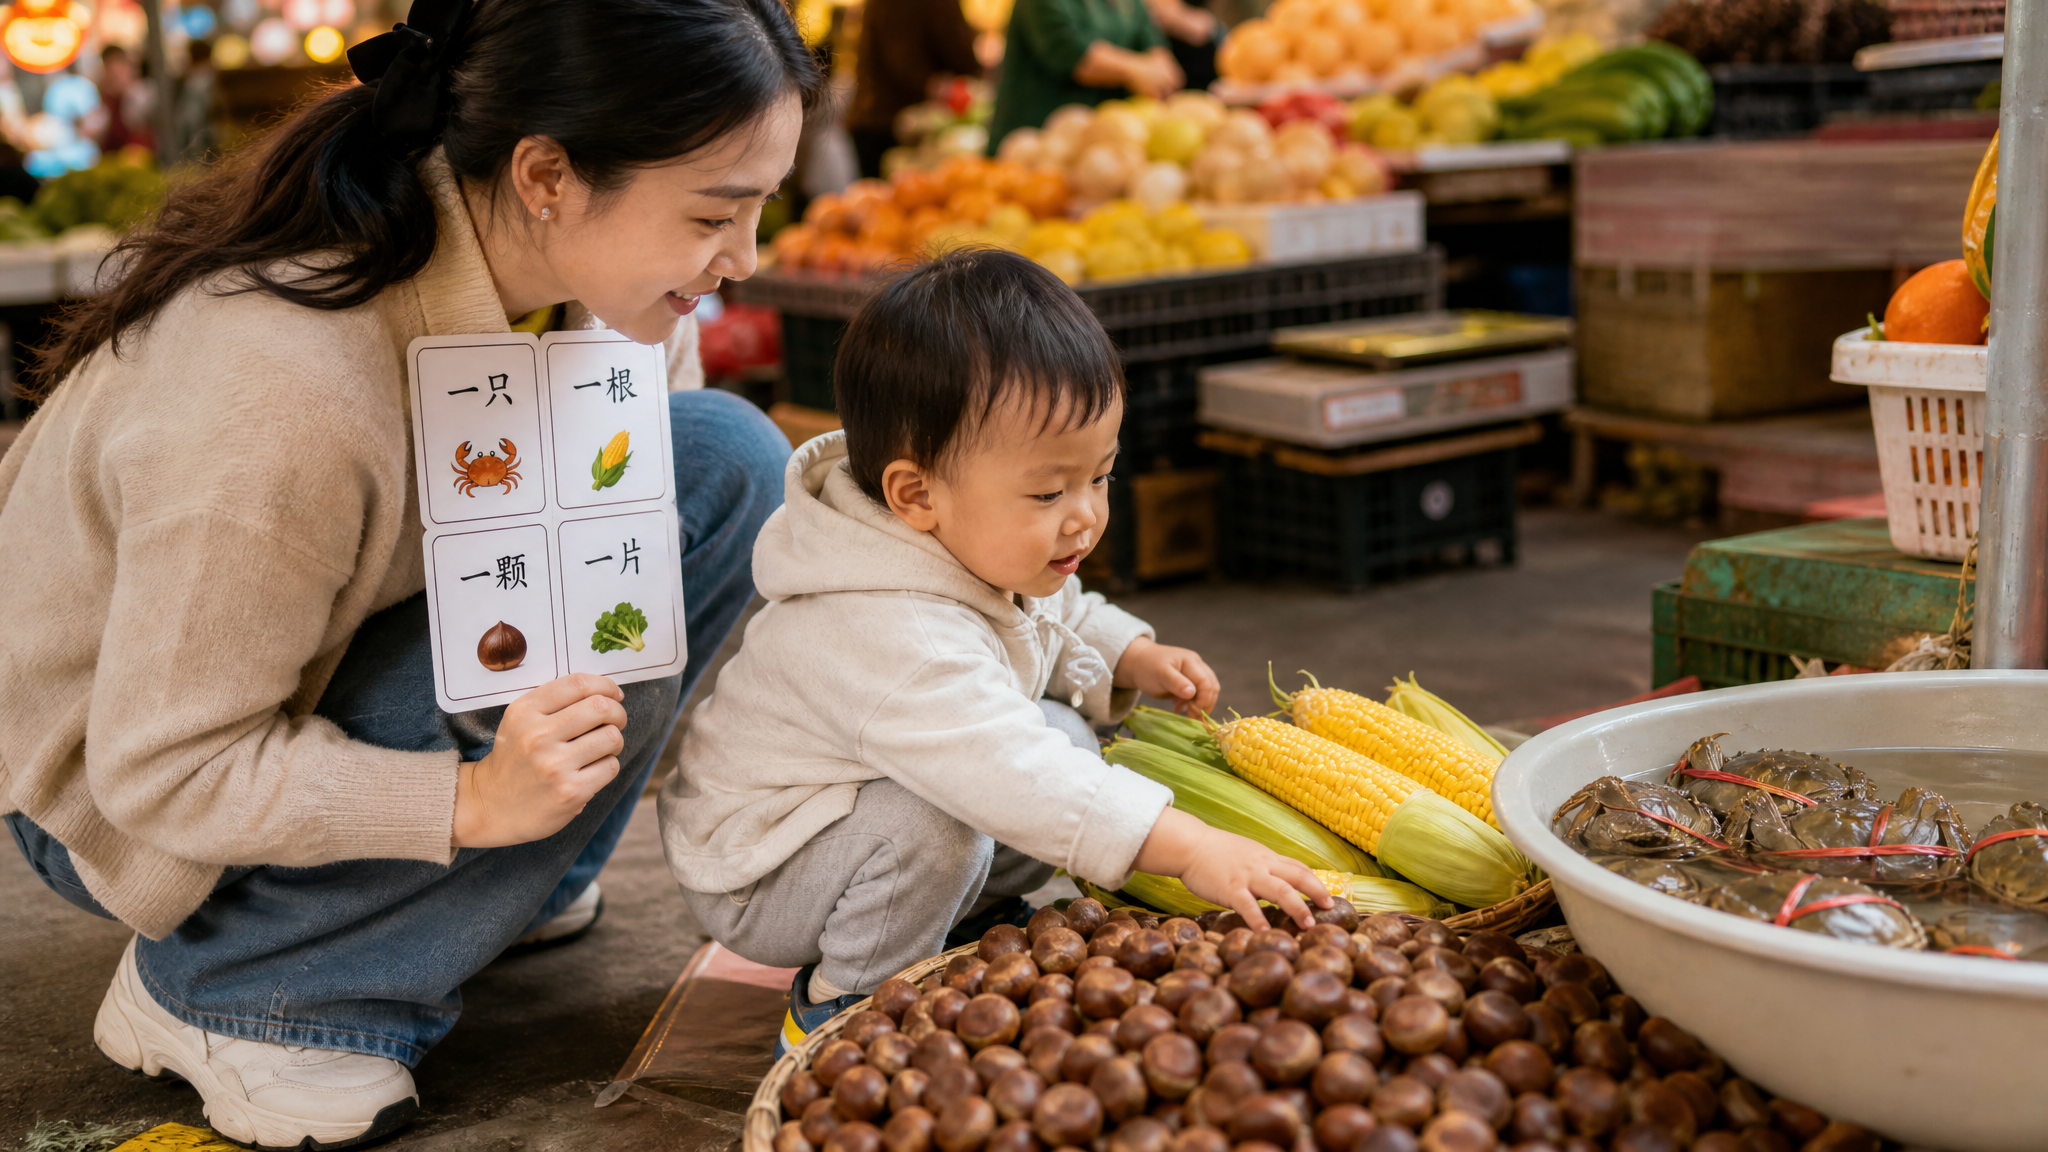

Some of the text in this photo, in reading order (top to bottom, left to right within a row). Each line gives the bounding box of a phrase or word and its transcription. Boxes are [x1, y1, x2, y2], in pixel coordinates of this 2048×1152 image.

[447, 373, 513, 407] 一只
[573, 367, 638, 403] 一根
[460, 553, 528, 591] 一颗
[584, 537, 642, 576] 一片
